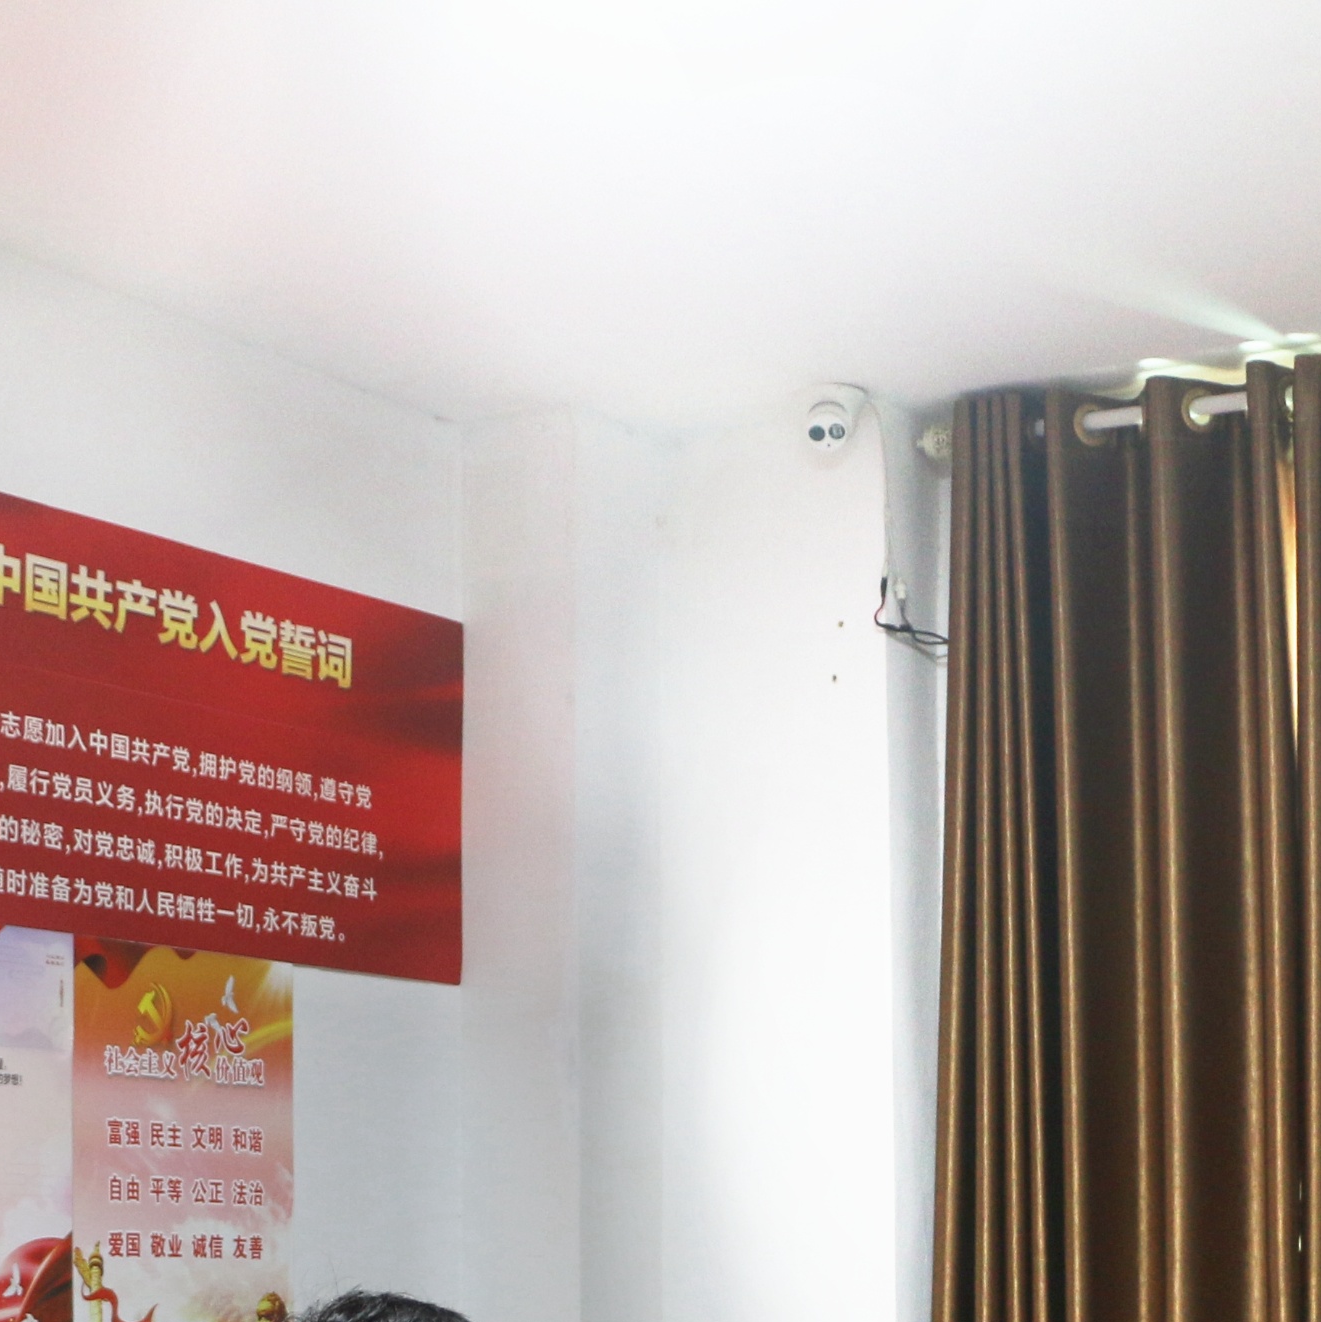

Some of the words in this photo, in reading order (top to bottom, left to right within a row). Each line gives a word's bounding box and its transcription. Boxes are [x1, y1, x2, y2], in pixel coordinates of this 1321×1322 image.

[107, 1118, 141, 1146] 富强
[150, 1122, 183, 1148] 民主
[191, 1125, 223, 1150] 文明
[232, 1128, 263, 1152] 和谐
[108, 1175, 140, 1202] 自由
[150, 1177, 183, 1203] 平等
[191, 1180, 224, 1204] 公正
[232, 1181, 263, 1206] 法治
[108, 1232, 141, 1258] 爱国
[150, 1232, 183, 1258] 敬业
[191, 1234, 223, 1259] 诚信
[232, 1235, 263, 1260] 友善
